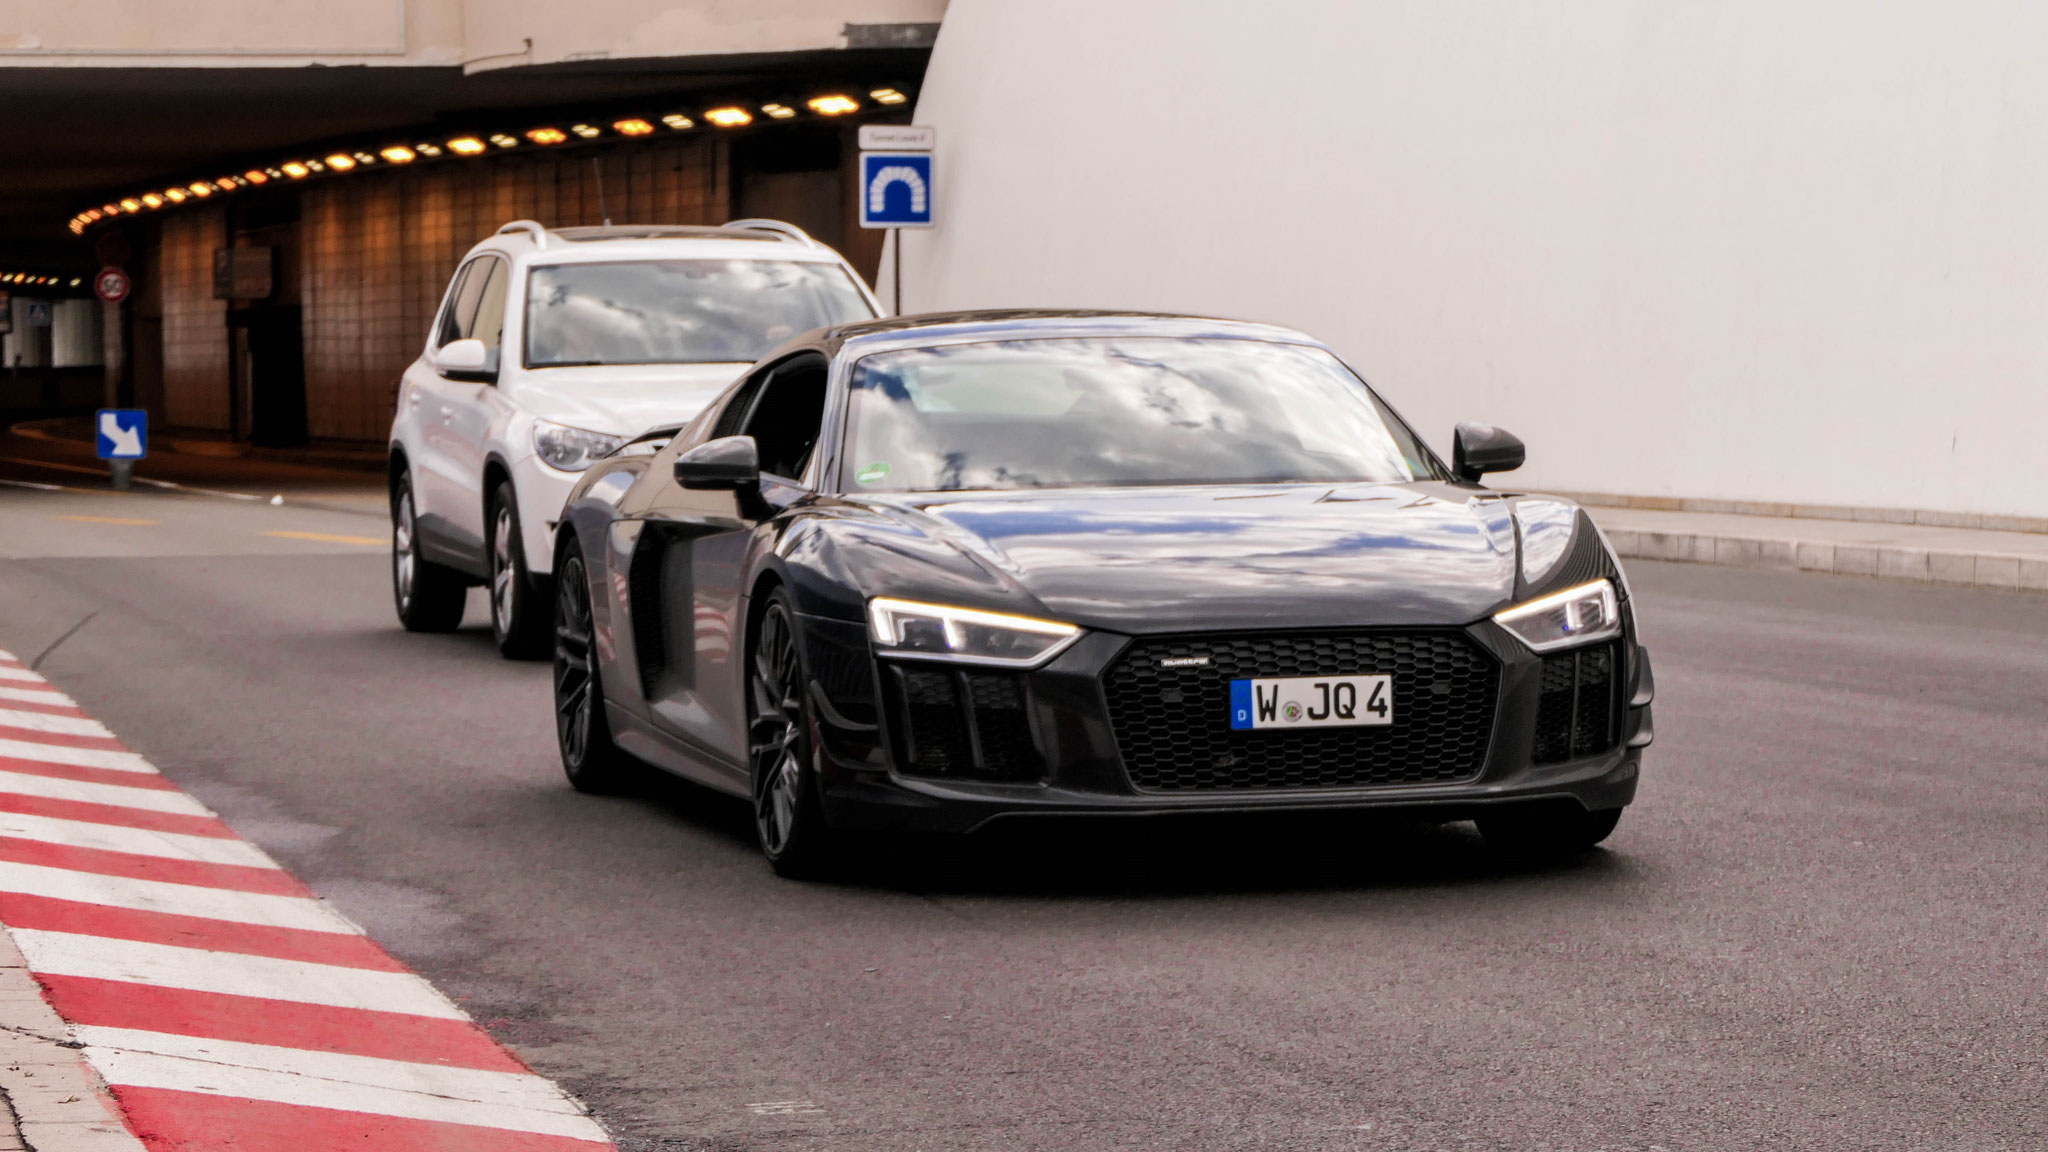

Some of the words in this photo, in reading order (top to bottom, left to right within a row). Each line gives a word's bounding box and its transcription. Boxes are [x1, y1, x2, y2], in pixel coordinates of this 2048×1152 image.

[1256, 684, 1279, 722] W
[1307, 682, 1356, 720] JQ
[1366, 681, 1388, 718] 4
[1237, 709, 1247, 721] D
